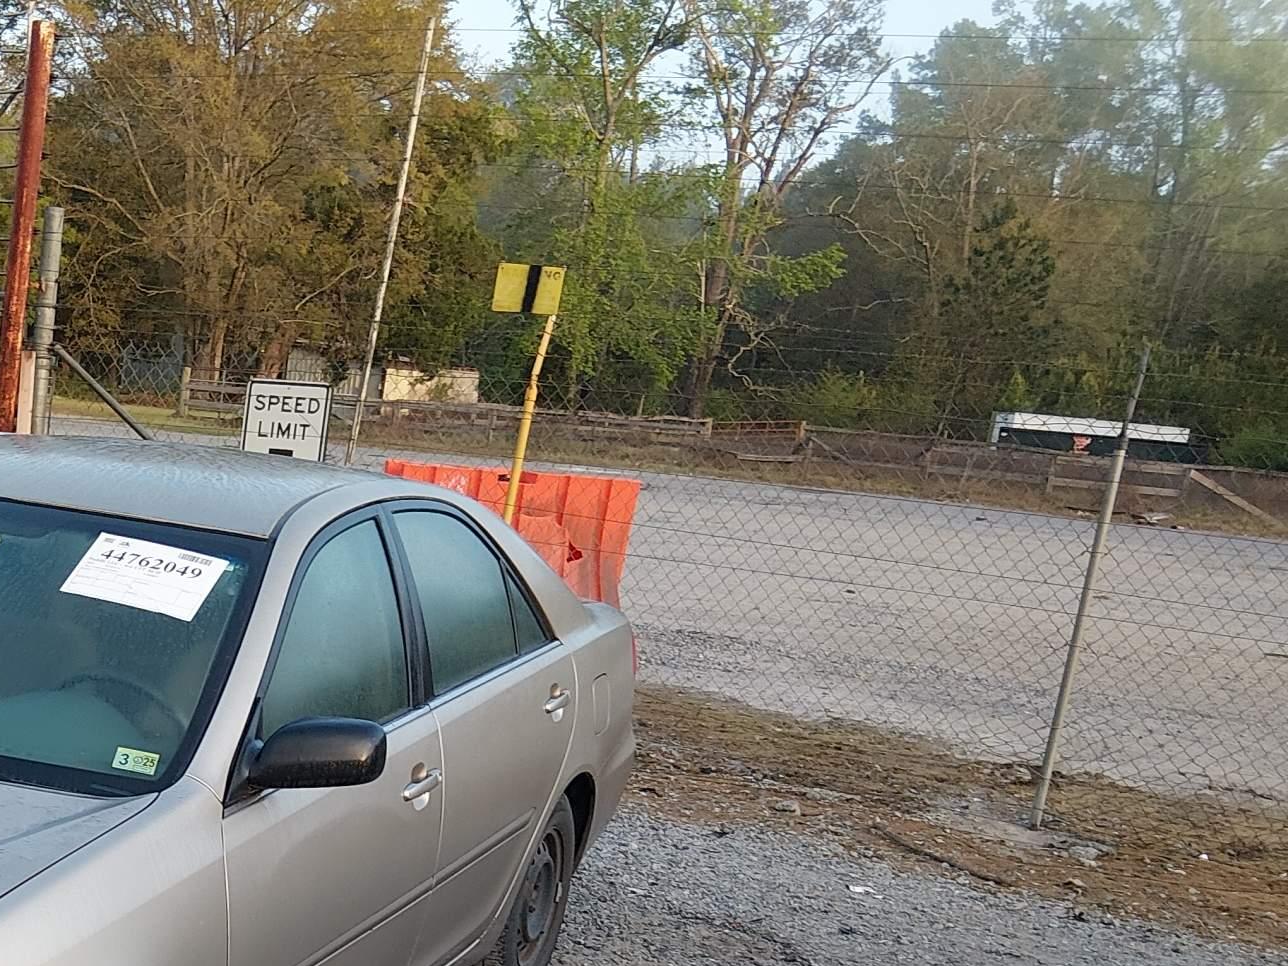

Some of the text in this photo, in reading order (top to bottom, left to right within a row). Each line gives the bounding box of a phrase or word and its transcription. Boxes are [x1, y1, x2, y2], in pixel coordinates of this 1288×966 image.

[254, 394, 321, 414] SPEED
[257, 420, 311, 441] LIMIT
[100, 549, 203, 579] 44762049
[119, 753, 129, 765] 3
